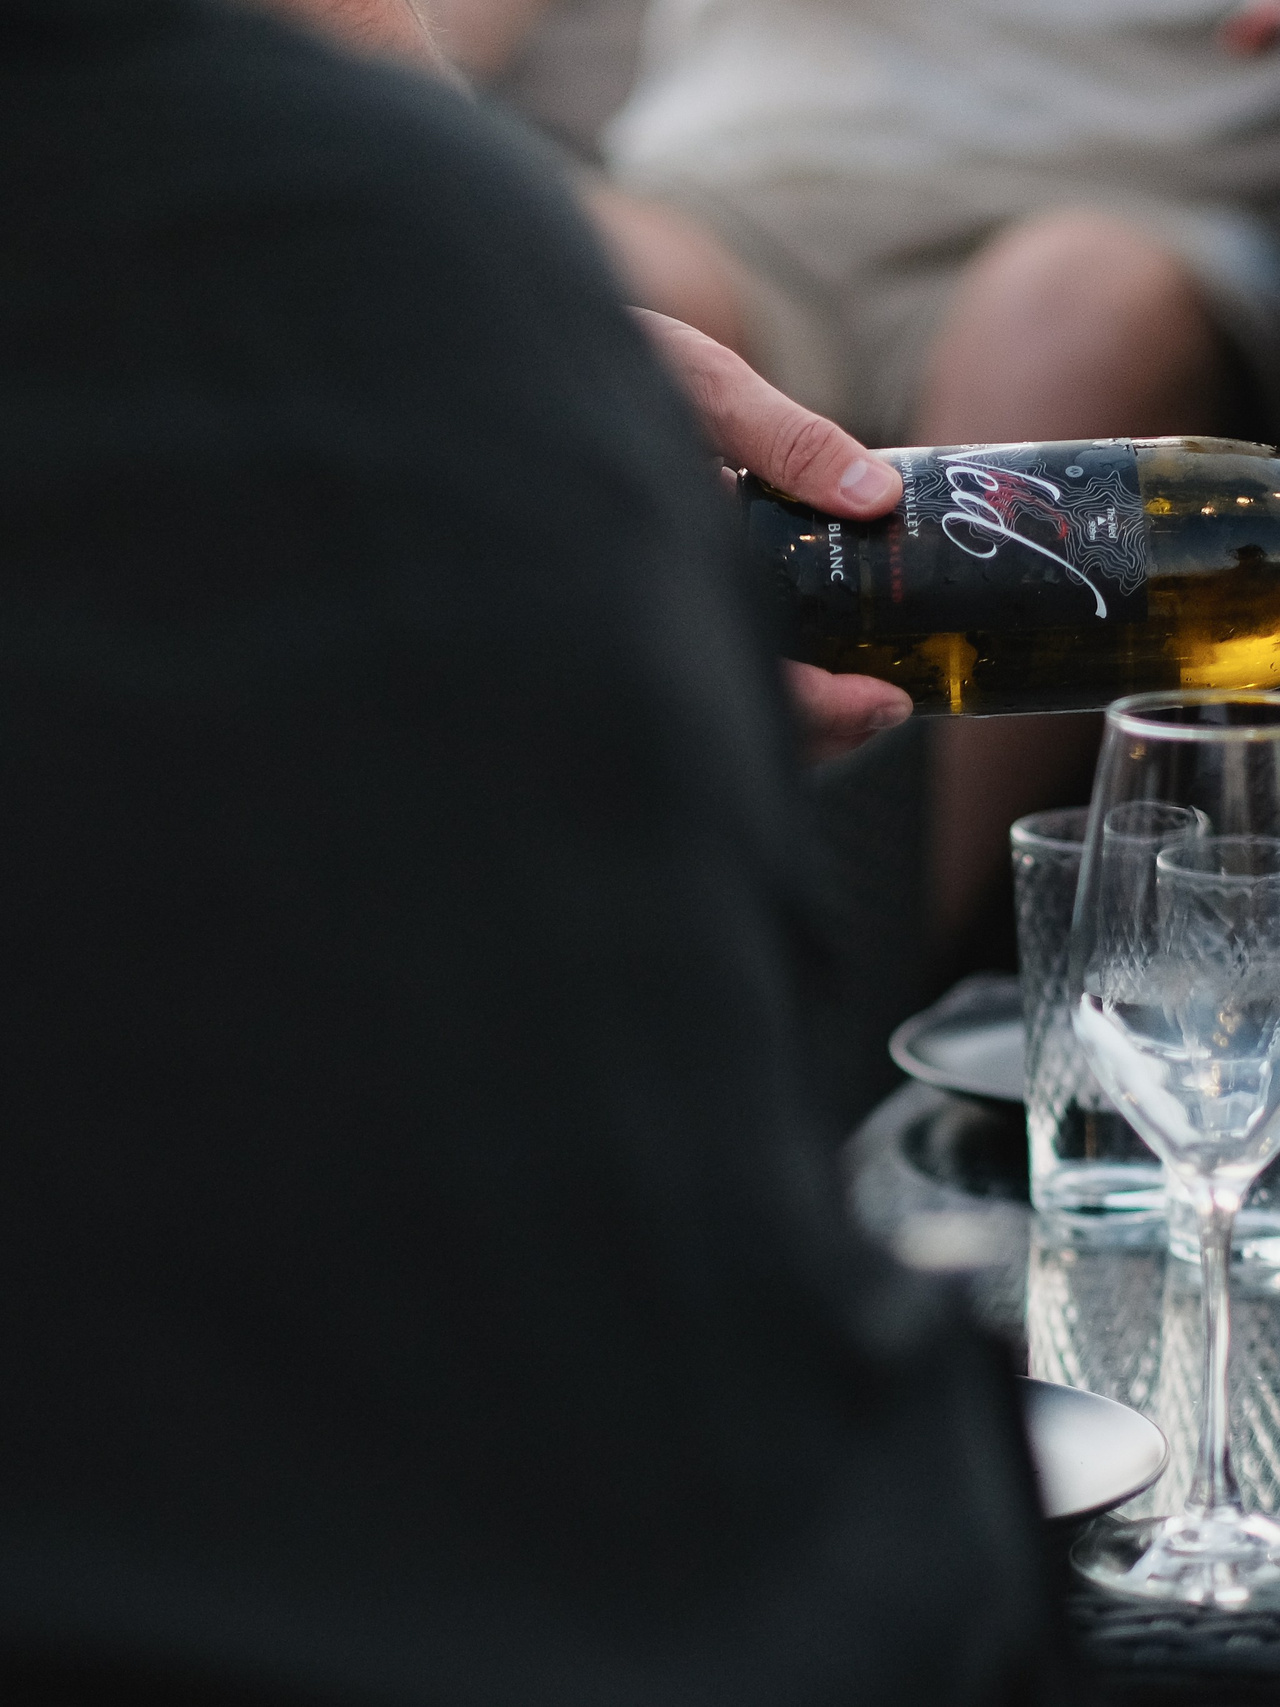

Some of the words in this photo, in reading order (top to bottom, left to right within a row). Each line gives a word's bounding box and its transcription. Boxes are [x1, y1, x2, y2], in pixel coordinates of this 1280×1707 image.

[903, 486, 919, 538] VALLEY
[1106, 507, 1116, 521] The
[1108, 522, 1119, 539] Ned
[827, 523, 844, 582] BLANC
